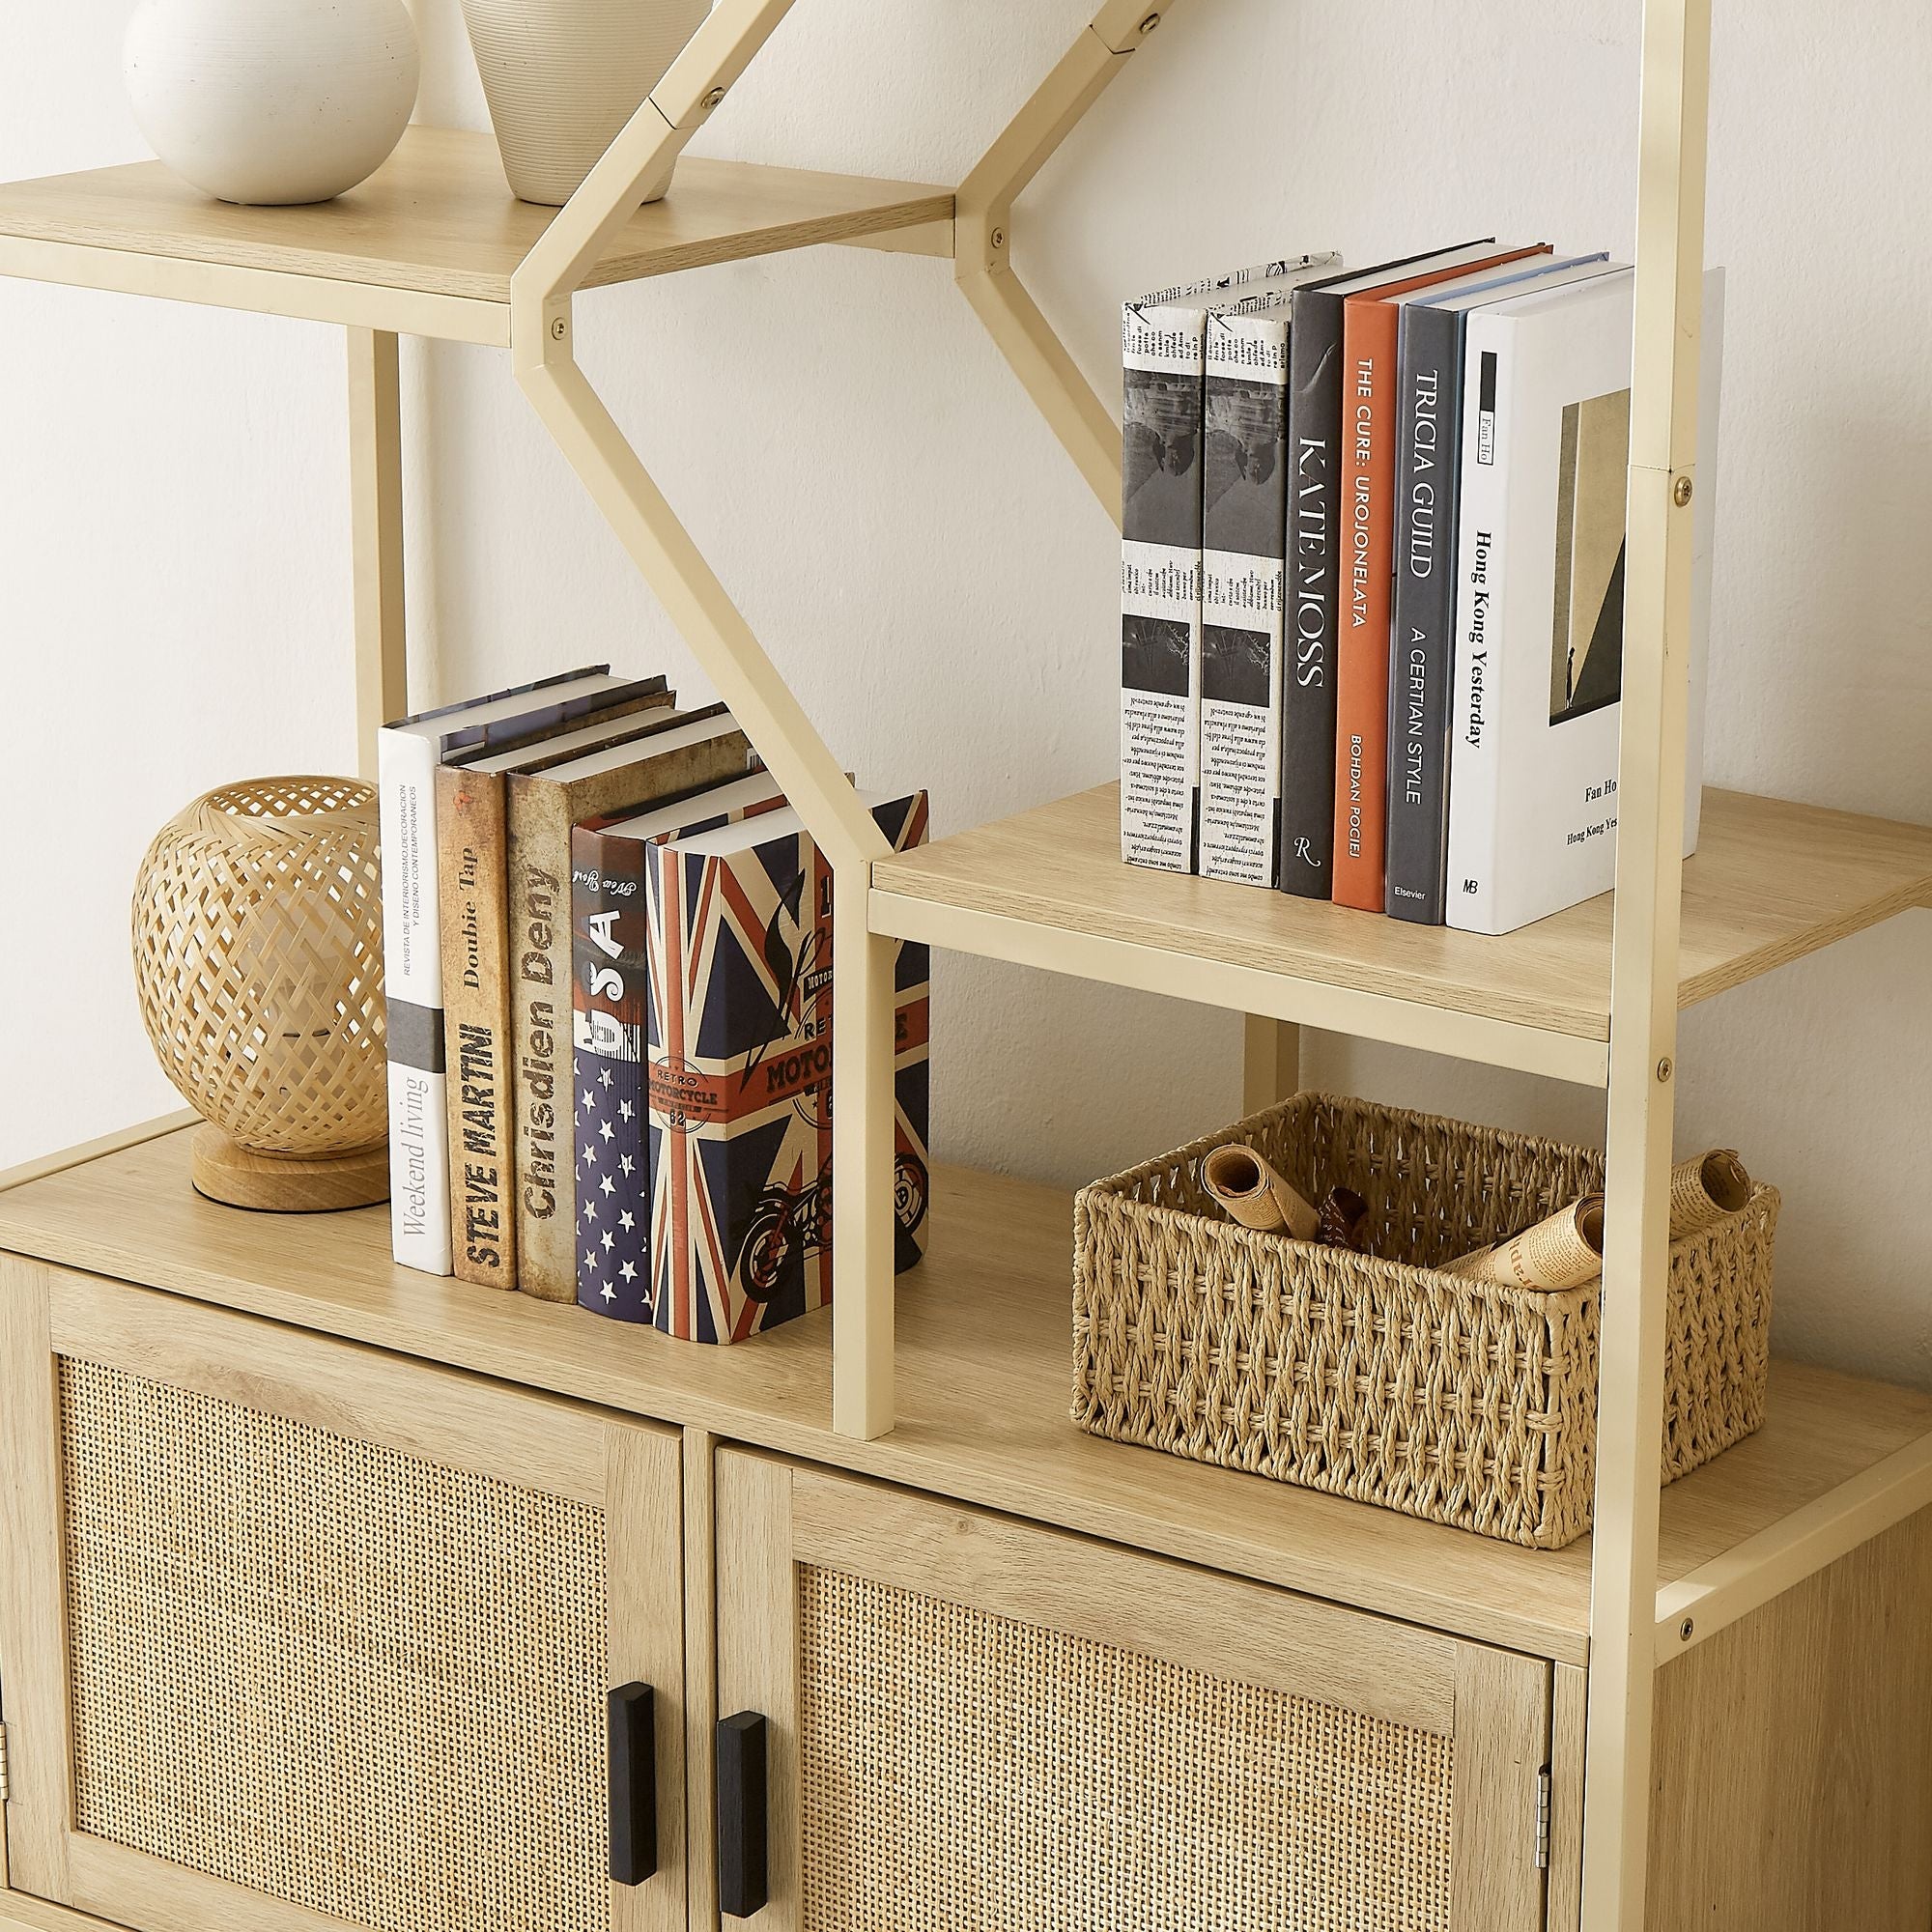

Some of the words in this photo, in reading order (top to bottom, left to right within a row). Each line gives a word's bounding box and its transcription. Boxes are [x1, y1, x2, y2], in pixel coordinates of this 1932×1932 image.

[1356, 358, 1373, 397] THE
[1355, 404, 1372, 467] CURE:
[1413, 369, 1437, 473] TRICIA
[1482, 418, 1492, 440] Fan
[1480, 443, 1491, 461] Ho
[1352, 476, 1370, 627] UROJONELATA
[1409, 482, 1435, 579] GUILD
[1470, 530, 1492, 585] Hong
[1410, 627, 1427, 642] A
[1468, 590, 1489, 644] Kong
[1407, 648, 1426, 736] CERTIAN
[1465, 650, 1487, 749] Yesterday
[1350, 734, 1362, 802] BOHDAN
[1406, 741, 1423, 805] STYLE
[1585, 786, 1602, 803] Fan
[1604, 779, 1617, 795] Ho
[410, 785, 419, 880] CONTEMPORANEOS
[1293, 836, 1322, 867] R
[1349, 806, 1360, 858] POCIEJ
[1567, 831, 1585, 845] Hong
[1585, 823, 1605, 838] Kong
[458, 847, 478, 892] Tap
[572, 869, 600, 893] York
[602, 879, 637, 896] New
[1394, 886, 1426, 900] Elsevier
[403, 921, 411, 935] DE
[521, 864, 560, 986] Deny
[573, 909, 640, 1064] USA
[459, 1023, 497, 1157] MARTINI
[648, 1079, 719, 1106] MOTORCYCLE
[657, 1069, 698, 1089] RETRO
[766, 1041, 834, 1094] MOTO
[399, 1076, 429, 1139] living
[522, 1000, 556, 1220] Chrisdien
[401, 1142, 426, 1236] Weekend
[465, 1162, 500, 1268] STEVE
